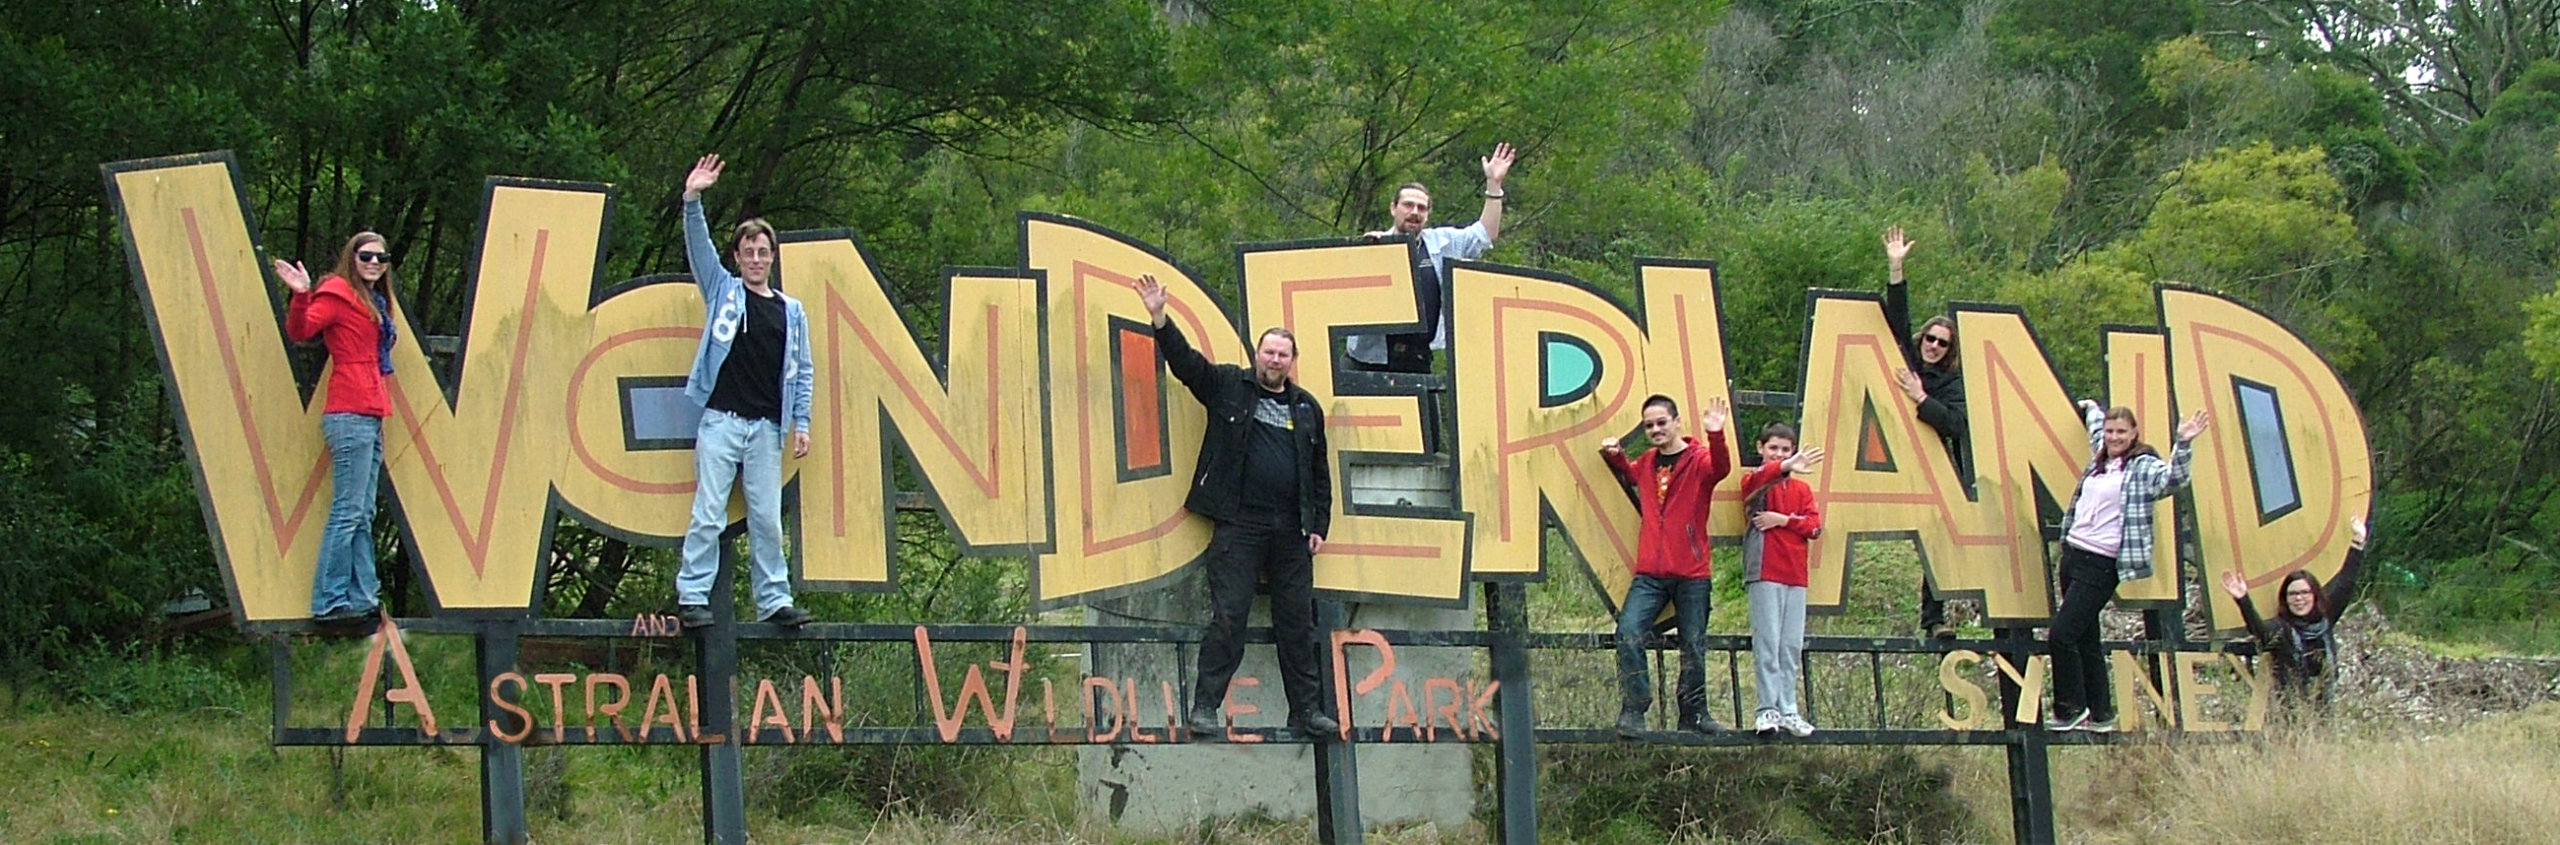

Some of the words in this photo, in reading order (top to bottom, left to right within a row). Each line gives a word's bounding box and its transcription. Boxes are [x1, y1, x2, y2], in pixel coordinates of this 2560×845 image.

[101, 152, 2374, 638] WONDERLAND
[345, 613, 844, 743] ASTRALIAN
[1331, 629, 1500, 741] PARK
[631, 612, 680, 637] AND
[1939, 649, 2274, 733] SYNEY
